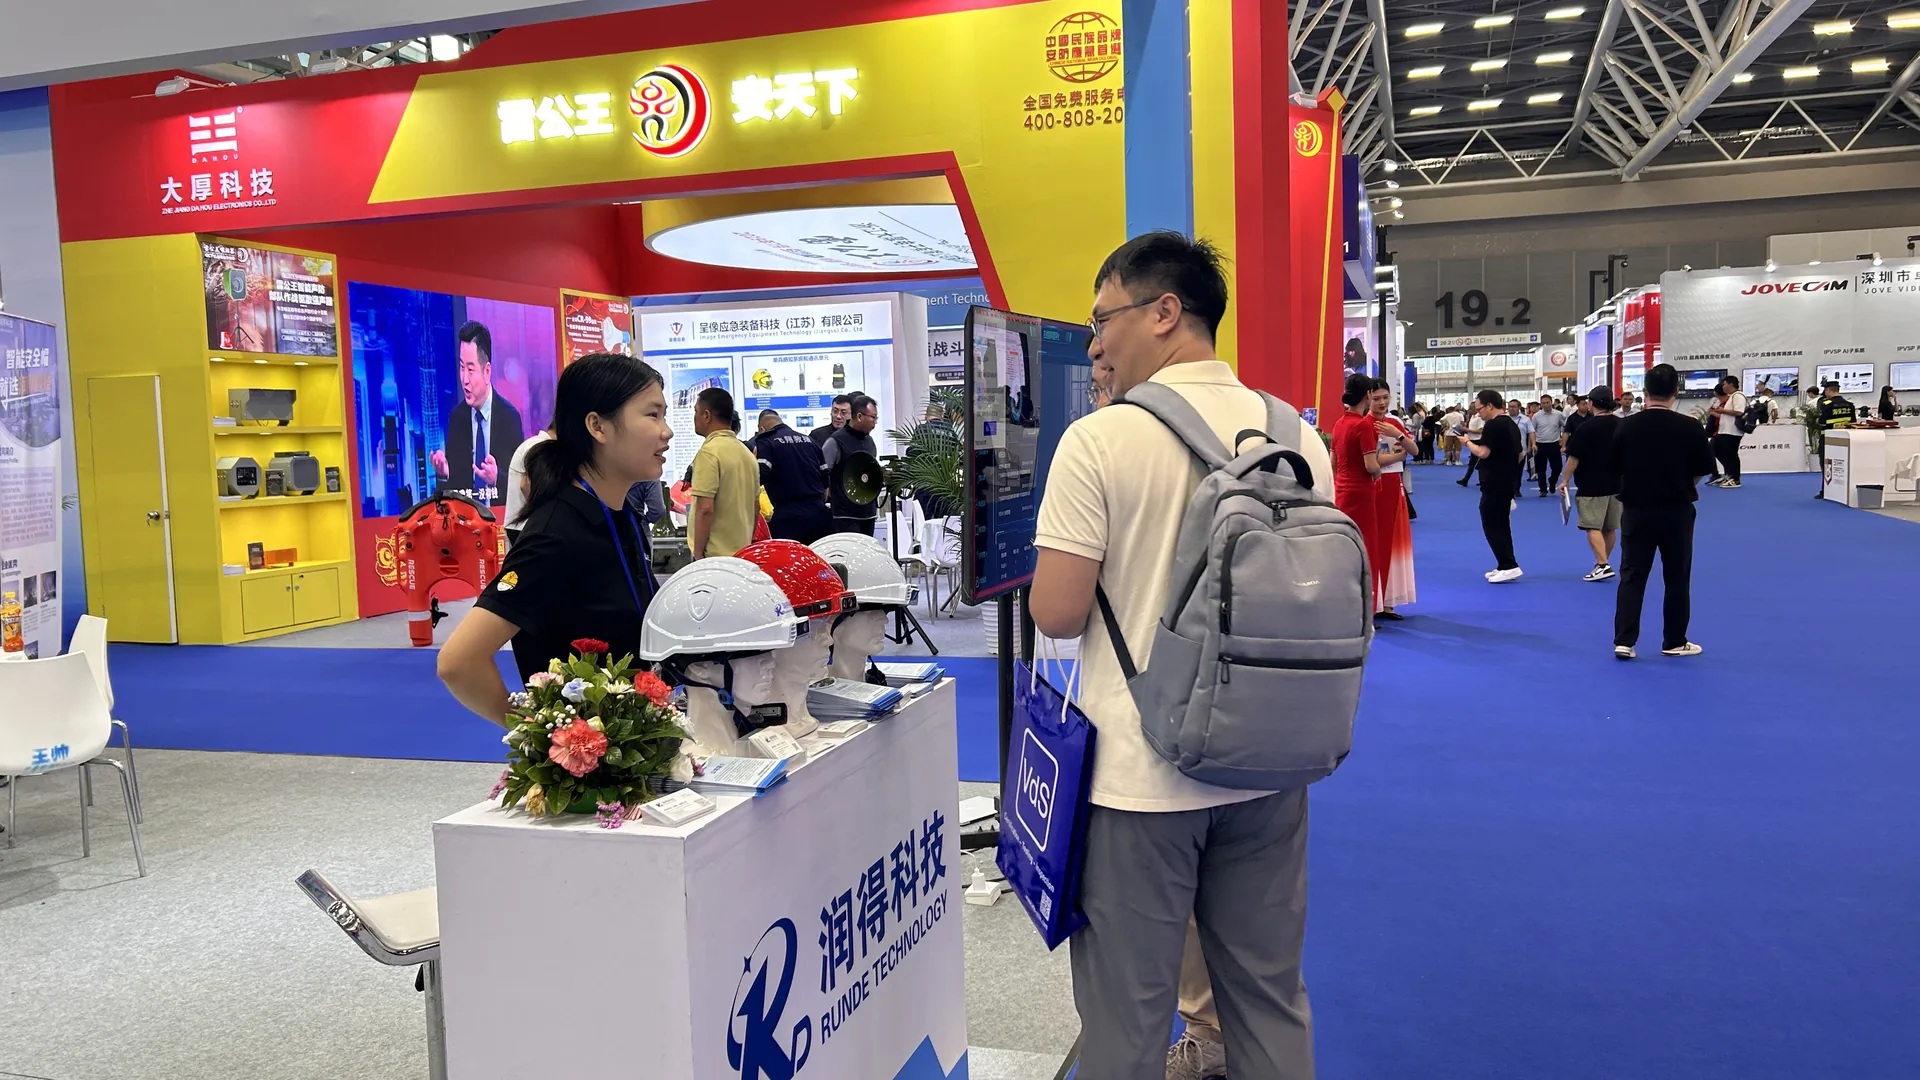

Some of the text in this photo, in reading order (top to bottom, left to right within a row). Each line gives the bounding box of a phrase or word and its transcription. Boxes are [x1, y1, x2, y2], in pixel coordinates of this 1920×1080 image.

[731, 67, 860, 125] 安天下
[497, 92, 615, 144] 雷公王
[1024, 106, 1124, 131] 400-808-20
[192, 154, 239, 163] DAHOU
[160, 167, 275, 205] 大厚科技
[161, 207, 174, 215] ZHE
[213, 201, 253, 210] ELECTRONICS
[1741, 280, 1849, 296] JOVECAM
[1864, 285, 1920, 295] JOVE VID
[1435, 289, 1531, 329] 19.2
[780, 329, 812, 337] Technology
[6, 347, 49, 370] 智能安全帽
[407, 559, 416, 591] RESCUE
[479, 558, 487, 590] RESCUE
[1023, 757, 1050, 819] VdS
[818, 809, 948, 995] 润得科技
[820, 888, 948, 1046] RUNDE TECHNOLOGY
